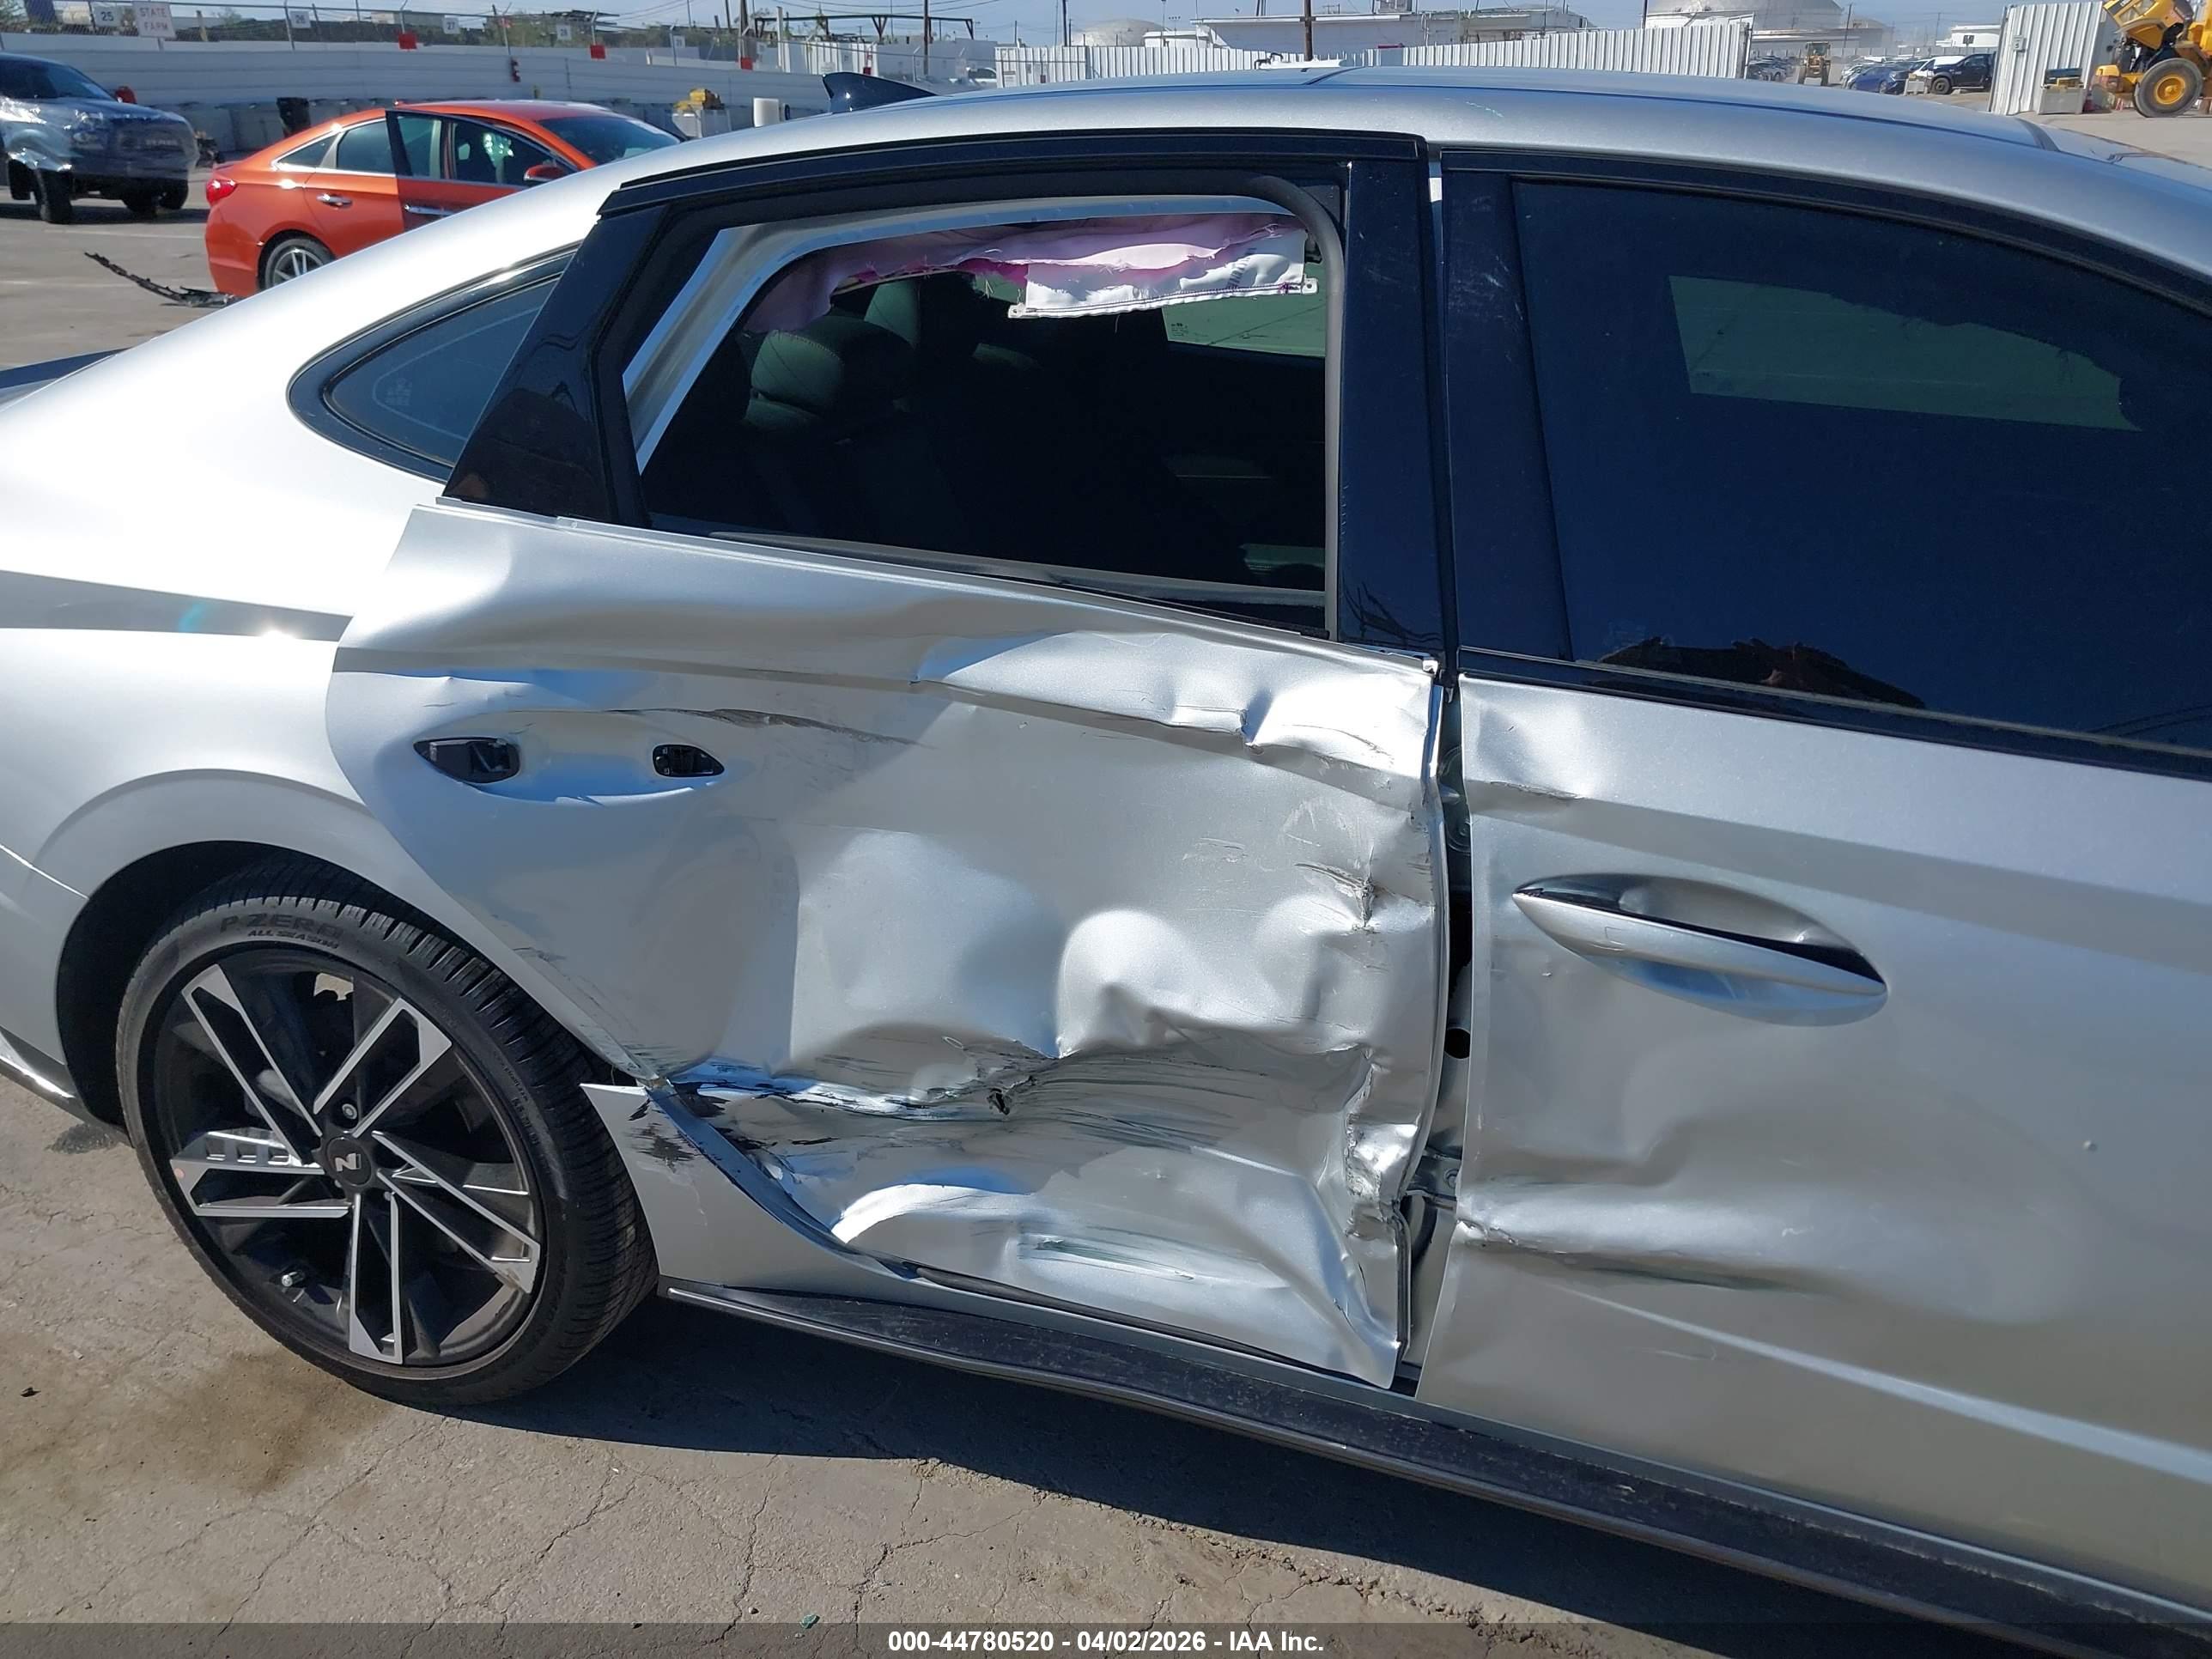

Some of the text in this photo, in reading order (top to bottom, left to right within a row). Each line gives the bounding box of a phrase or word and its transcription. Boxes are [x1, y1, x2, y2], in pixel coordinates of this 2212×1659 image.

[100, 11, 113, 21] 25
[140, 7, 166, 17] STATE
[143, 21, 168, 30] FARM
[220, 913, 343, 939] P ZERO
